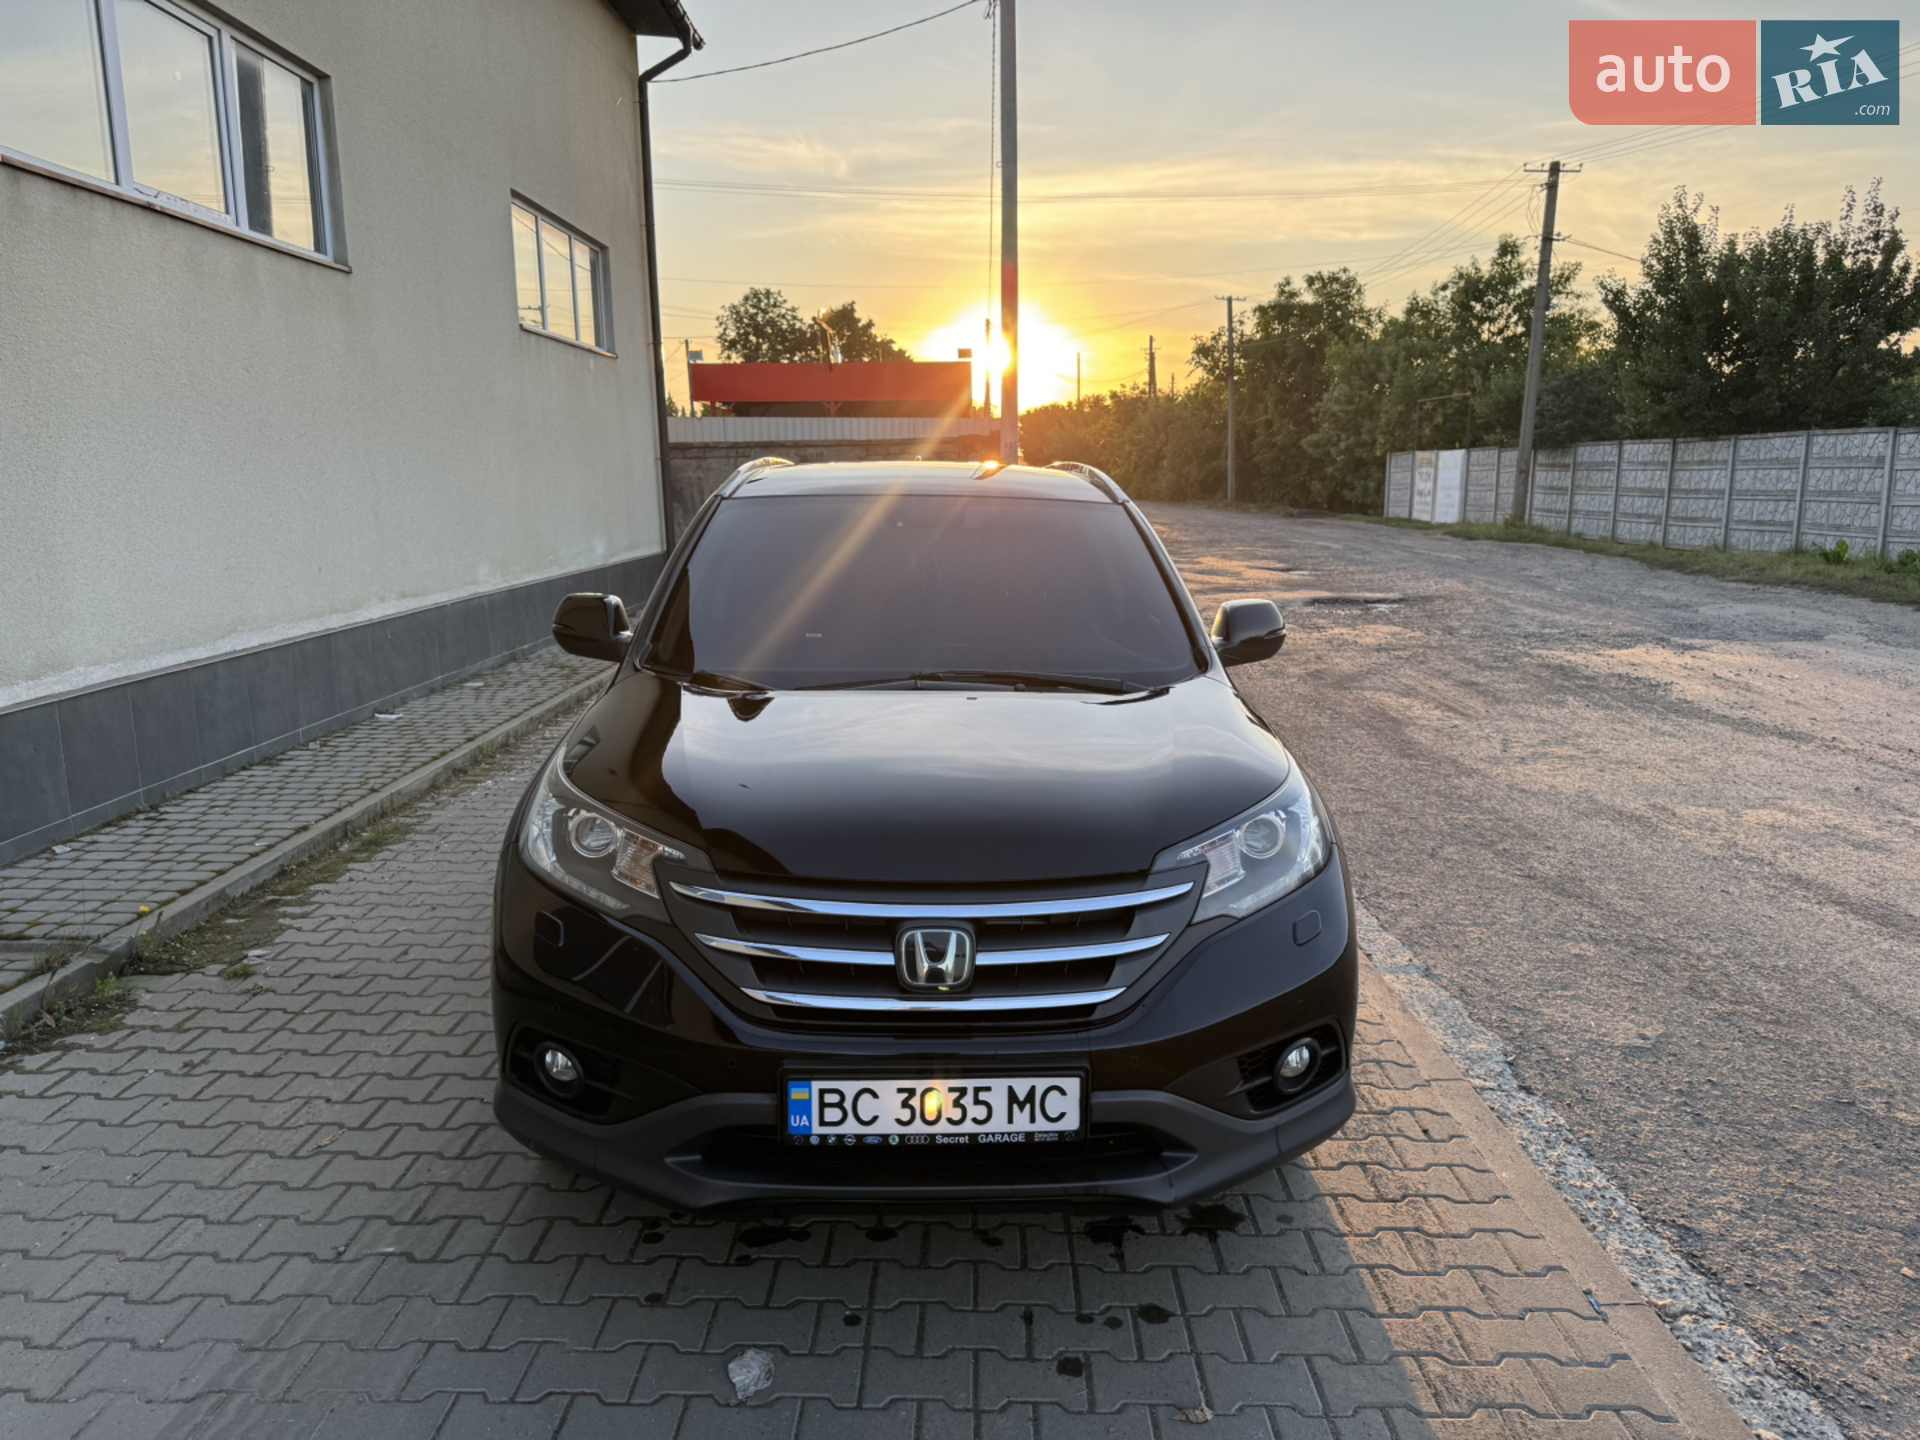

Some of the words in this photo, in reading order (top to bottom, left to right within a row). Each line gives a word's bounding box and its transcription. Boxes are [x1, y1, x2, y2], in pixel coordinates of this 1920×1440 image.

[817, 1087, 880, 1127] BC
[894, 1085, 993, 1126] 3035
[1007, 1084, 1068, 1125] MC
[790, 1115, 810, 1127] UA
[935, 1134, 970, 1144] Secret
[977, 1132, 1026, 1144] GARAGE
